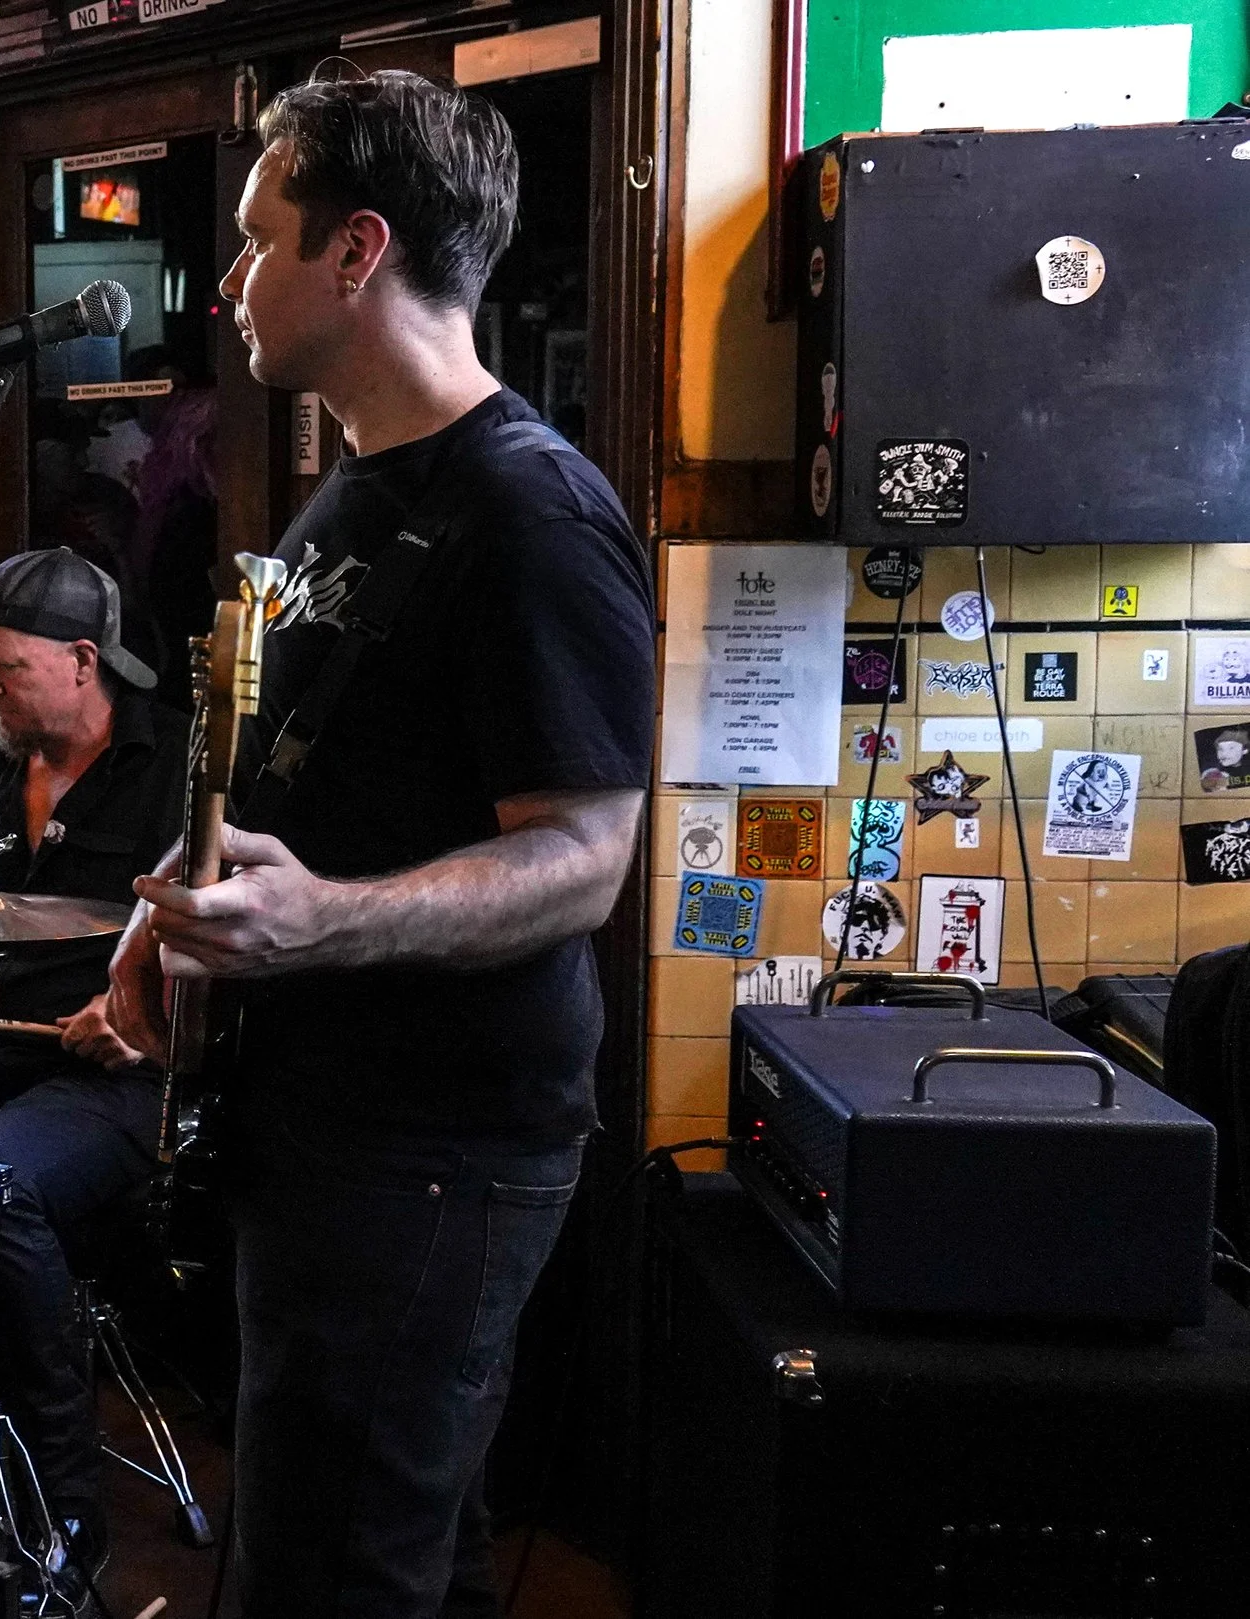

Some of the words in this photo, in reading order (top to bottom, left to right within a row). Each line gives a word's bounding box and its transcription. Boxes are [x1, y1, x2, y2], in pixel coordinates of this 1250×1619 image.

[77, 8, 98, 27] NO
[101, 153, 117, 162] PAST
[119, 151, 136, 160] THIS
[138, 147, 163, 157] POINT
[108, 386, 125, 394] PAST
[127, 384, 143, 392] THIS
[145, 383, 168, 391] POINT
[300, 405, 312, 460] PUSH
[879, 444, 912, 461] JUNGLE
[913, 443, 934, 454] JIM
[935, 444, 966, 461] SMITH
[735, 571, 776, 596] tote
[934, 731, 977, 742] chloe
[950, 915, 967, 924] THE
